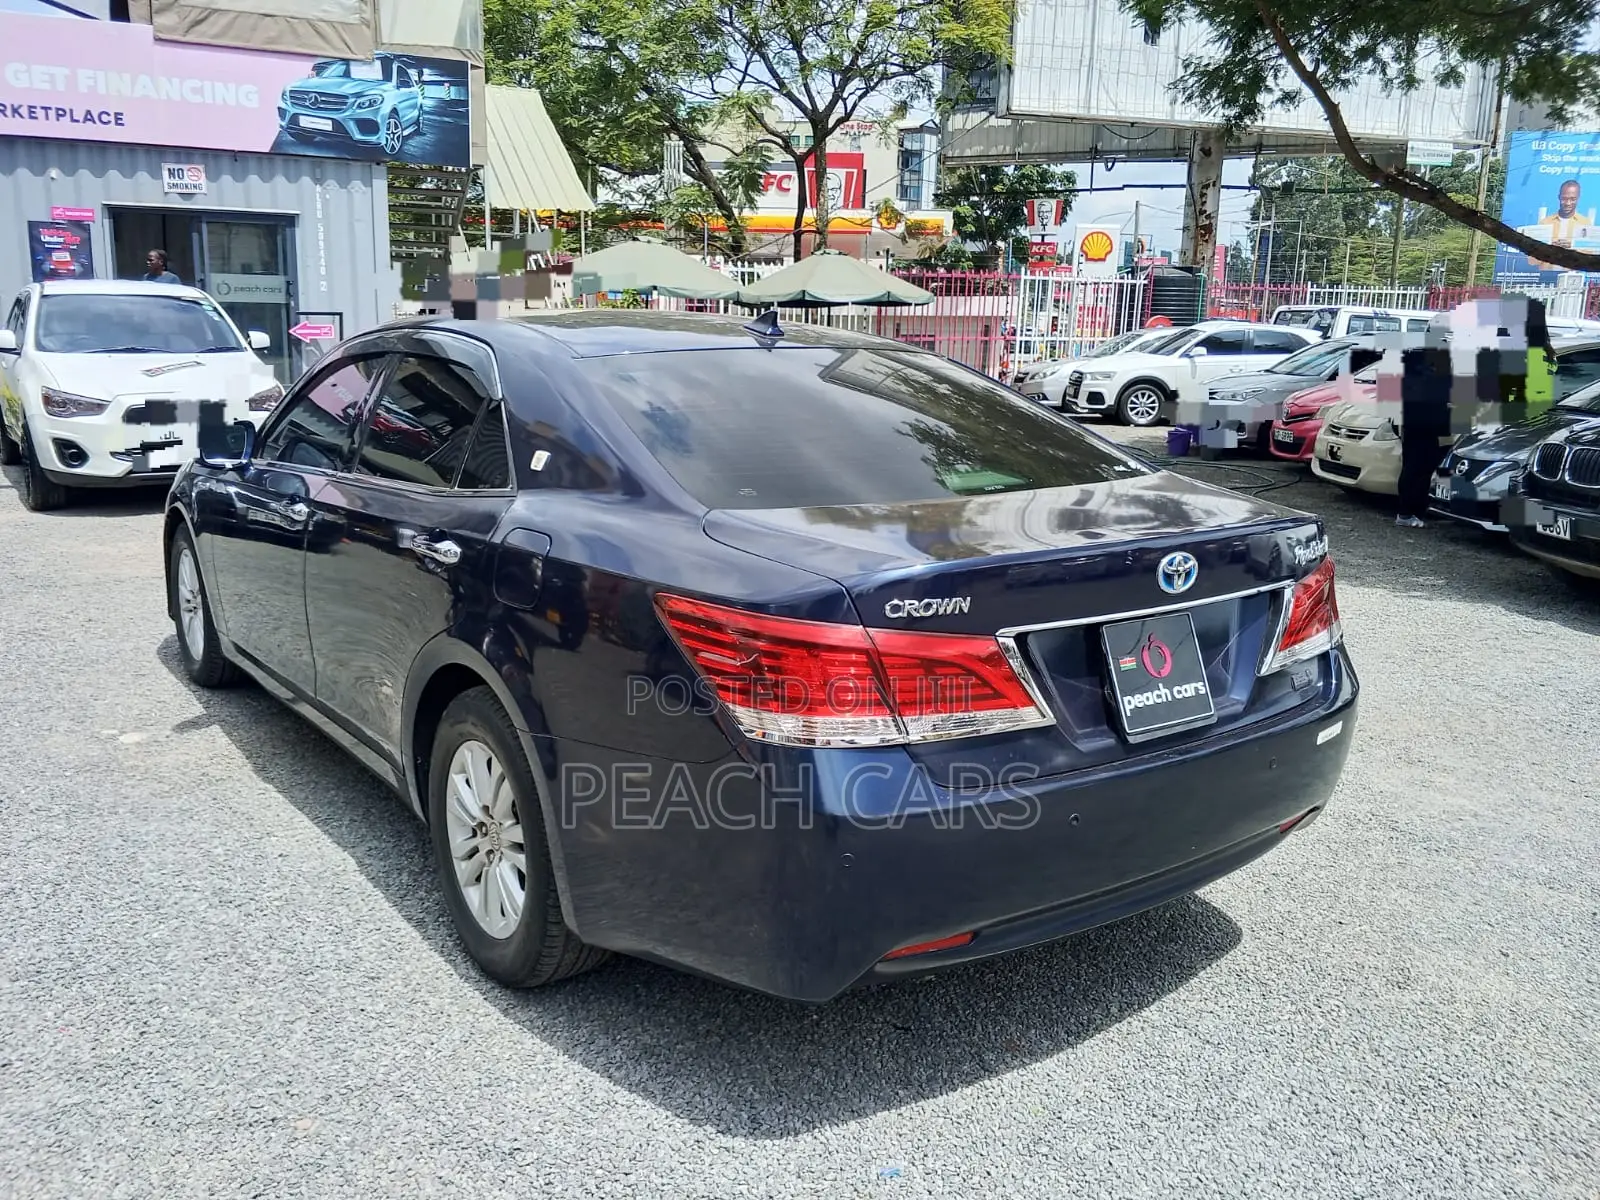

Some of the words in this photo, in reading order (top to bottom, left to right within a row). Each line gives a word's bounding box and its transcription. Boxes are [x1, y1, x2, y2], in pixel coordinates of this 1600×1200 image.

[4, 62, 72, 92] GET
[77, 68, 260, 108] FINANCING
[1549, 141, 1575, 152] Copy
[167, 167, 185, 180] NO
[1539, 165, 1563, 175] Copy
[167, 182, 204, 191] SMOKING
[1031, 245, 1055, 254] KFC
[233, 284, 262, 294] peach
[263, 285, 283, 294] cars
[320, 281, 327, 292] 2
[884, 596, 971, 618] CROWN
[1122, 683, 1172, 716] peach
[1172, 681, 1206, 699] cars
